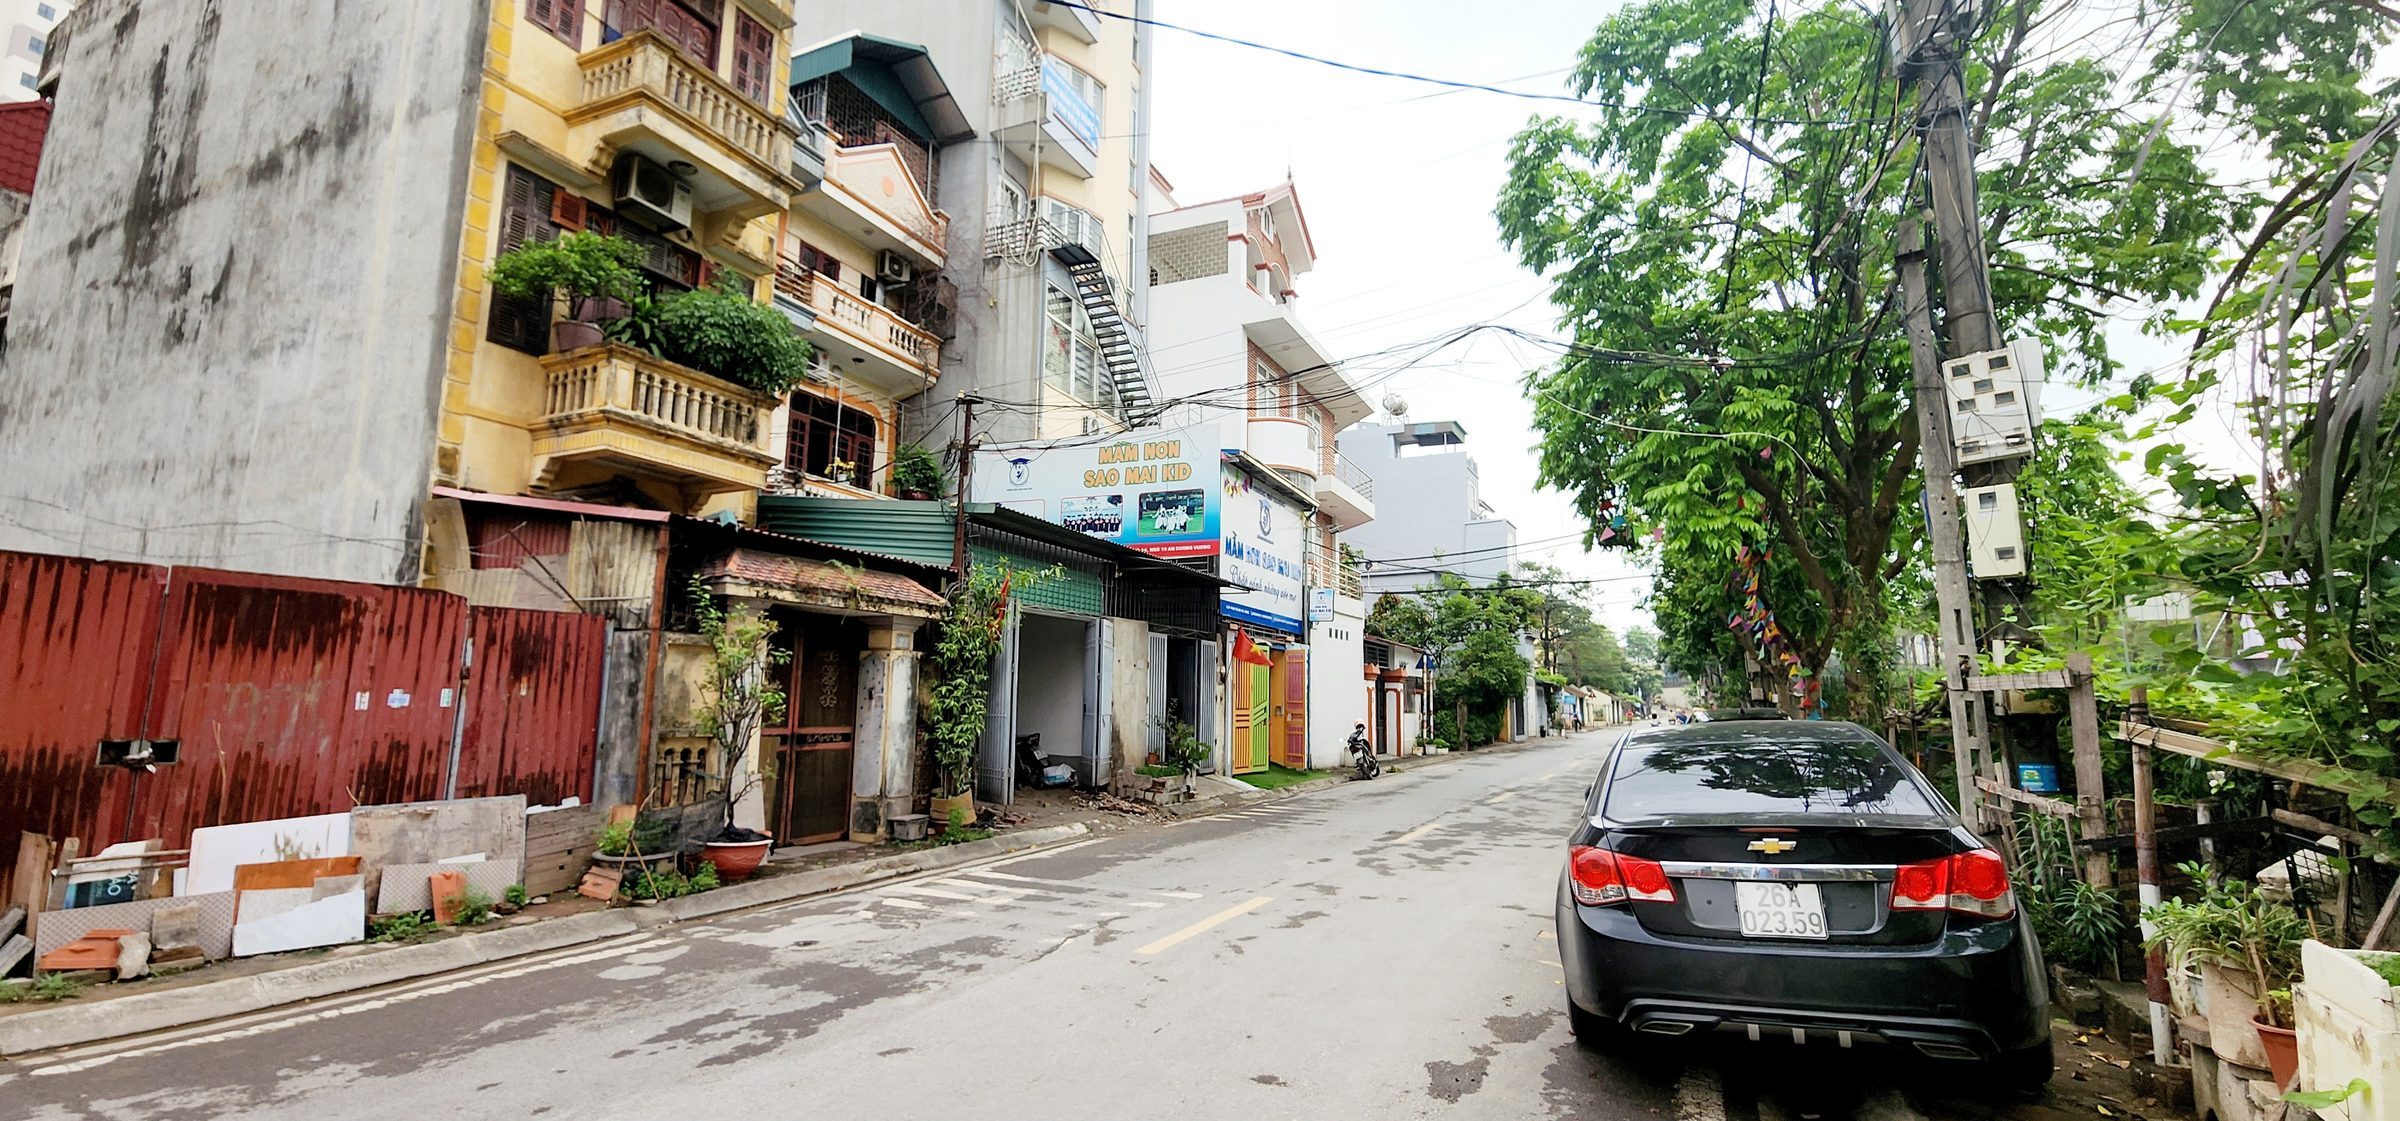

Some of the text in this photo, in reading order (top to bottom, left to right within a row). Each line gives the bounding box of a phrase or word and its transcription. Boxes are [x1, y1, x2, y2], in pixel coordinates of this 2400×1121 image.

[1144, 440, 1180, 460] NON
[1084, 462, 1192, 488] SAO MAI KID
[1755, 884, 1801, 908] 26A
[1743, 910, 1823, 935] 023.59
